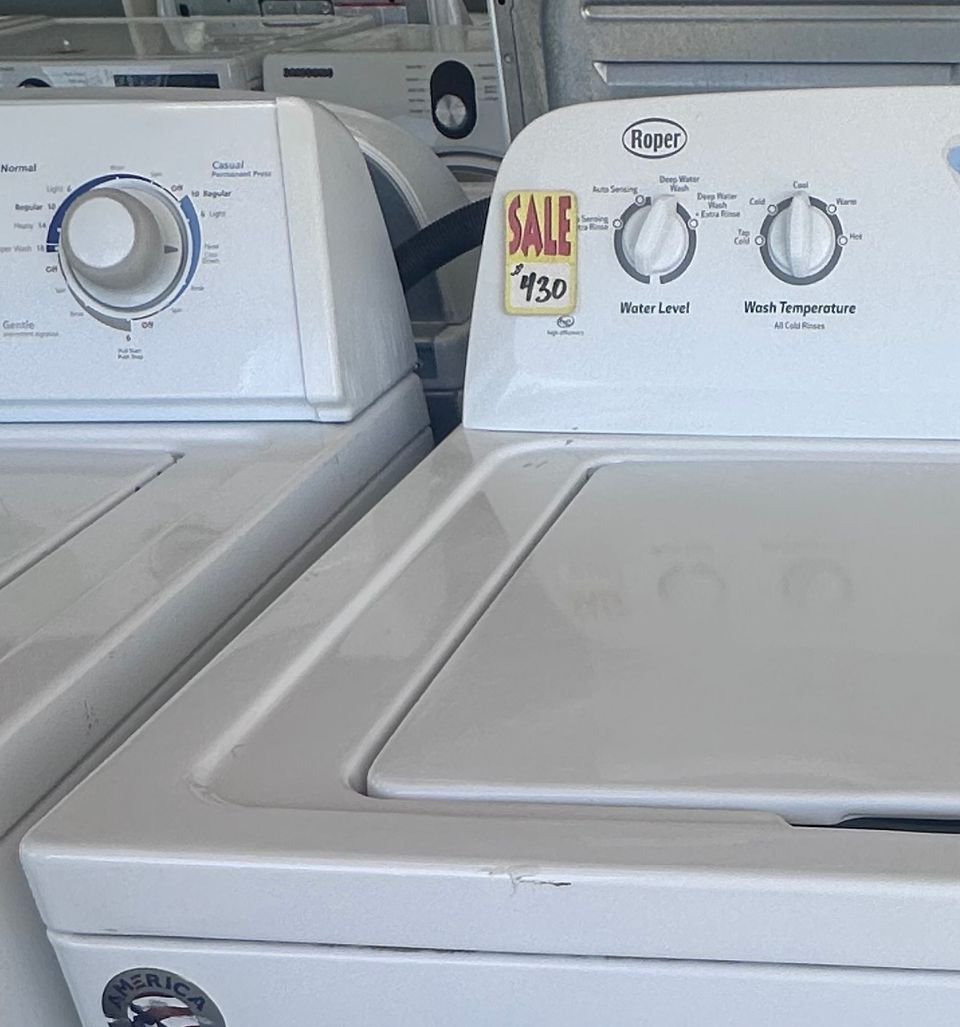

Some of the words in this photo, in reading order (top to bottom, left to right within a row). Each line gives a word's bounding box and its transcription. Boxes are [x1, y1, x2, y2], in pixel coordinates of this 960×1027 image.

[630, 129, 681, 152] Roper
[1, 164, 37, 173] Normal
[212, 161, 244, 170] Casual
[659, 175, 678, 184] Deep
[679, 175, 700, 183] Water
[592, 185, 609, 193] Auto
[610, 185, 638, 194] Sensing
[670, 184, 689, 192] Wash
[708, 201, 727, 209] Wash
[750, 198, 765, 206] Cold
[508, 192, 571, 257] SALE
[734, 237, 750, 245] Cold
[620, 302, 656, 314] Water
[658, 302, 690, 314] Level
[744, 301, 776, 314] Wash
[779, 301, 856, 316] Temperature
[2, 320, 35, 330] Gentle
[774, 321, 784, 330] All
[785, 321, 800, 330] Cold
[801, 321, 825, 330] Rinses
[107, 973, 206, 1012] AMERICA
